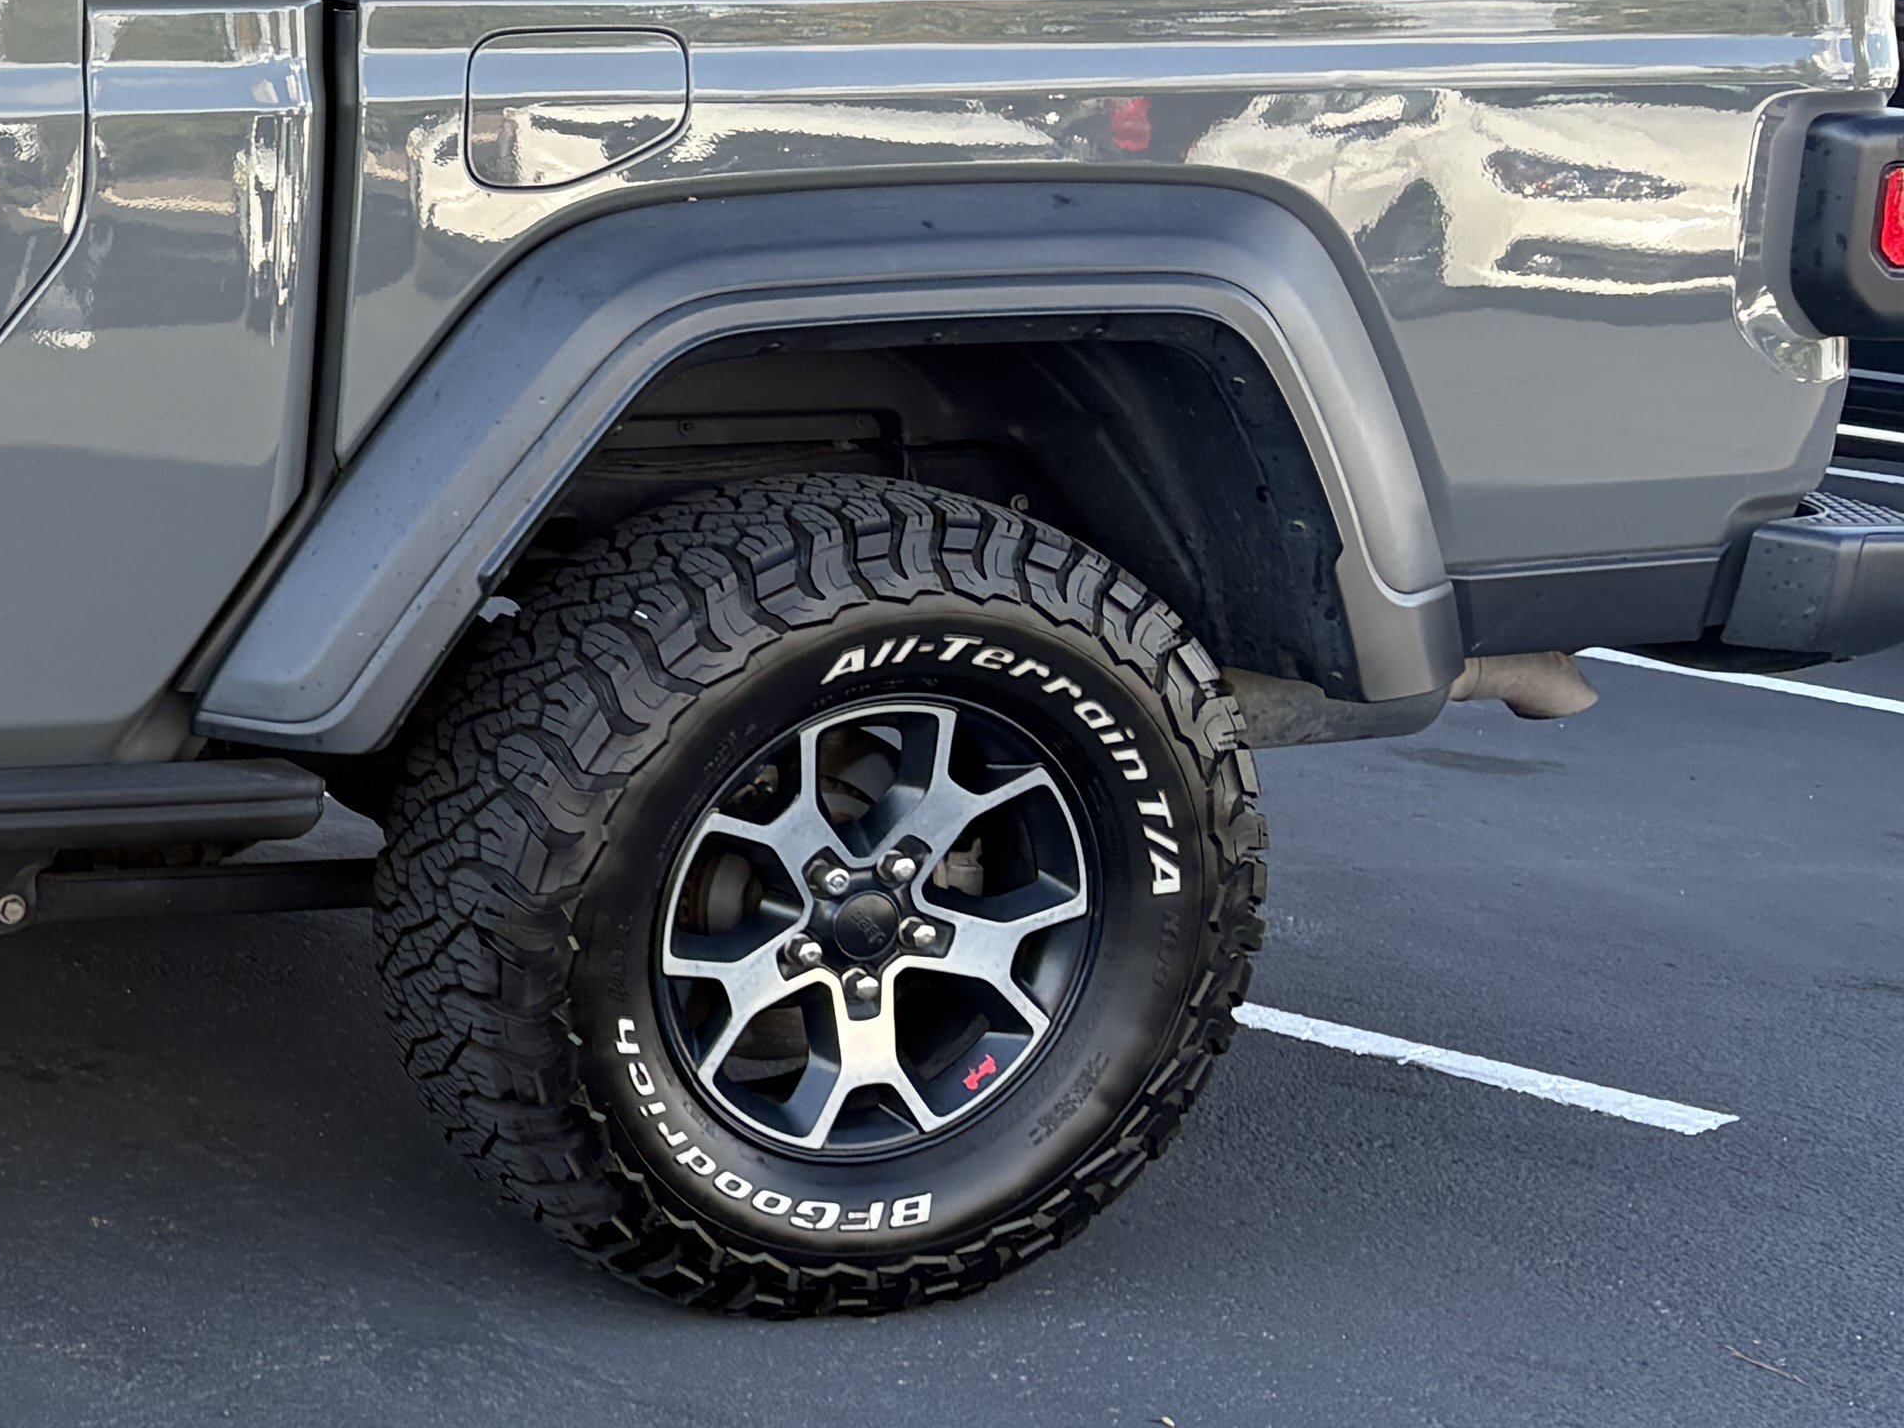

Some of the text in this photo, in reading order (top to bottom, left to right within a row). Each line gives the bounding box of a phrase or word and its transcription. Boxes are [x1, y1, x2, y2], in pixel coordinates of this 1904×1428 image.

[819, 635, 1182, 896] All-Terrain T/A
[614, 1018, 933, 1232] BFGoodrich
